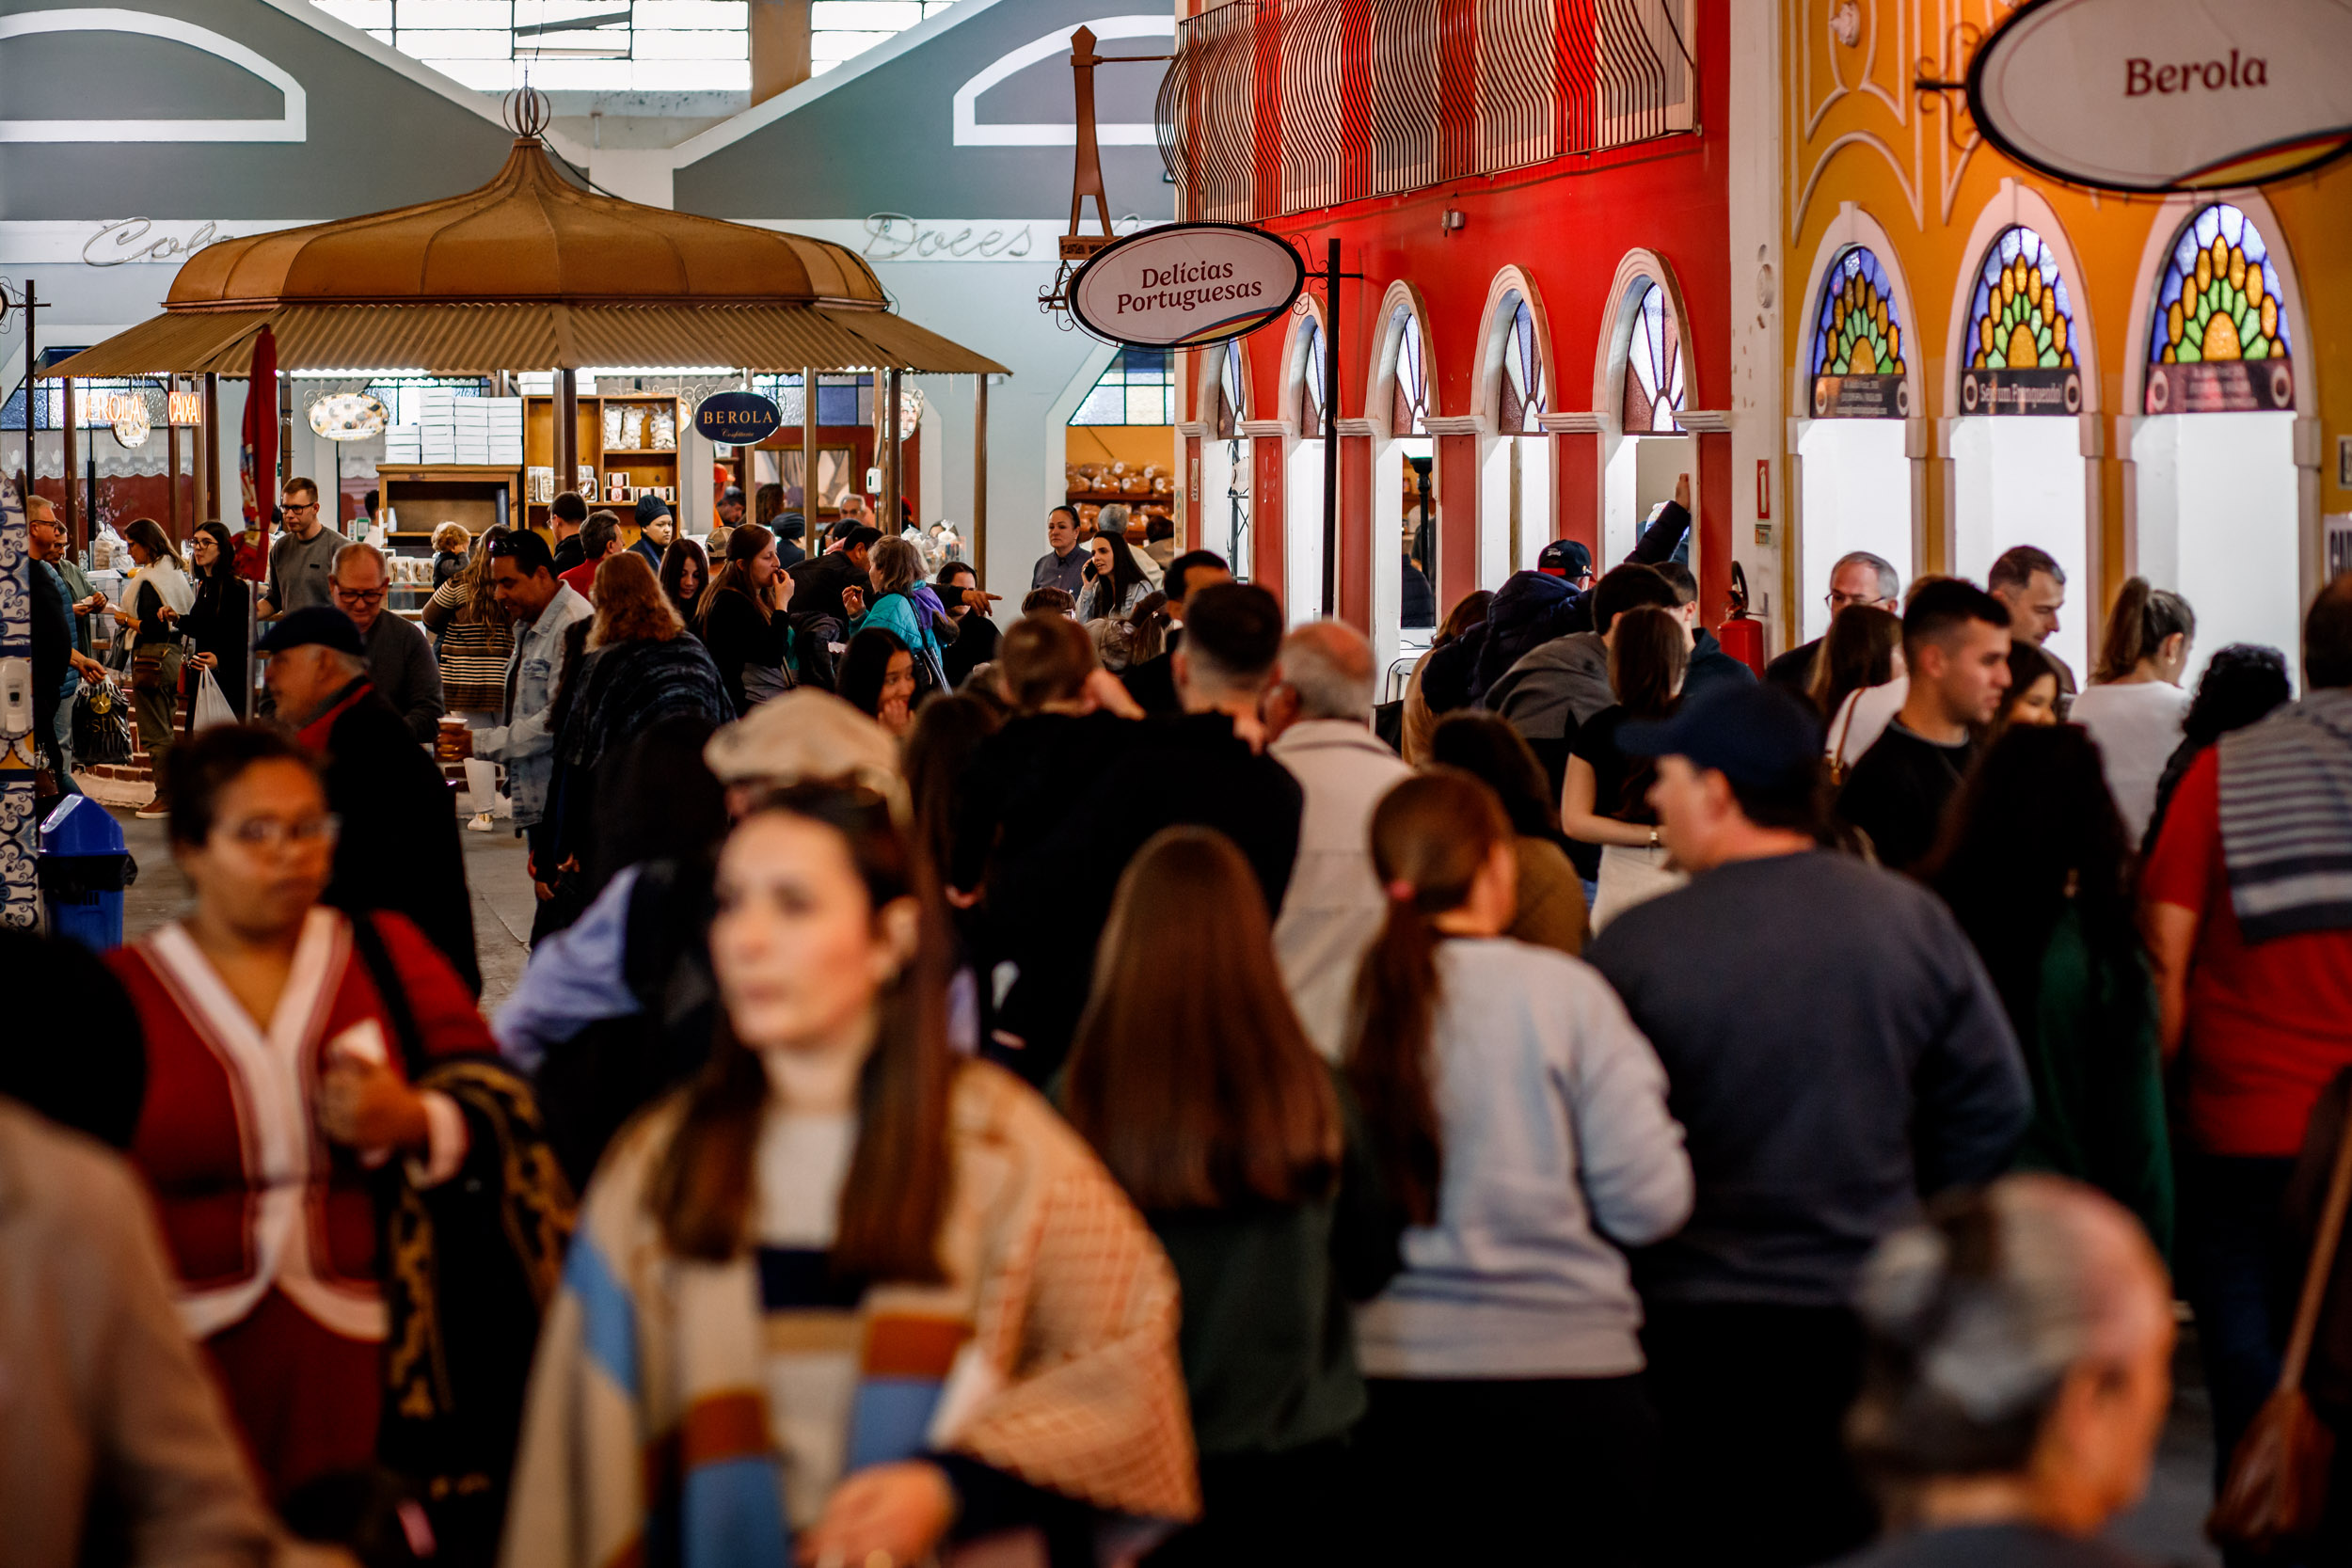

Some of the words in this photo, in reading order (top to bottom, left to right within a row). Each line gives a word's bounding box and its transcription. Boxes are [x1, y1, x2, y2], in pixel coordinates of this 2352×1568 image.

[2123, 47, 2268, 98] Berola
[863, 212, 1032, 261] Doces
[1141, 261, 1234, 289] Delícias
[1117, 281, 1263, 314] Portuguesas
[77, 394, 144, 422] BEROLA
[168, 393, 200, 423] CAIXA
[703, 410, 773, 424] BEROLA
